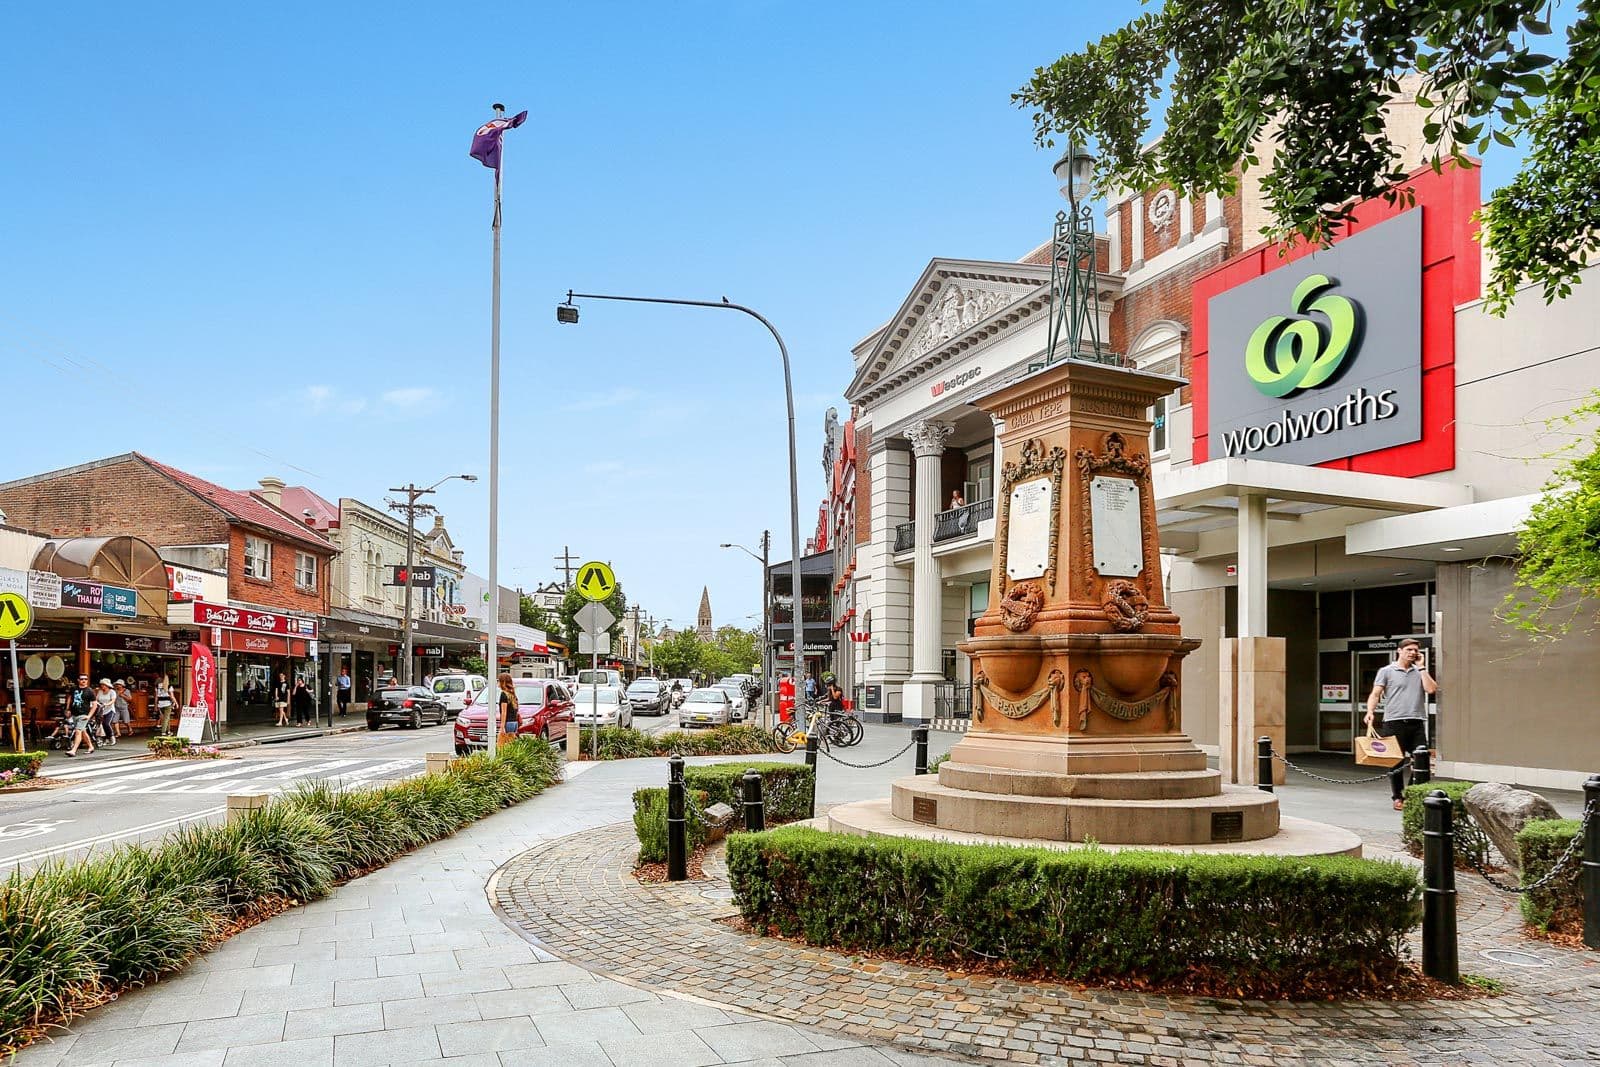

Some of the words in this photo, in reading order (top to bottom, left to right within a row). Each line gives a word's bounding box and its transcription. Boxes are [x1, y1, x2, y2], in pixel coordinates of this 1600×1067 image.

[931, 366, 981, 397] Westpac
[1040, 400, 1063, 419] TEPE
[1080, 401, 1138, 419] AUSTRALIA
[1221, 388, 1397, 456] woolworths
[412, 571, 431, 580] nab
[77, 594, 92, 604] THAI
[223, 611, 240, 626] Delight
[262, 617, 276, 631] Delight
[426, 647, 441, 655] nab
[802, 642, 833, 650] ululemon
[998, 701, 1030, 716] PEACE
[1110, 701, 1152, 717] HONOUR
